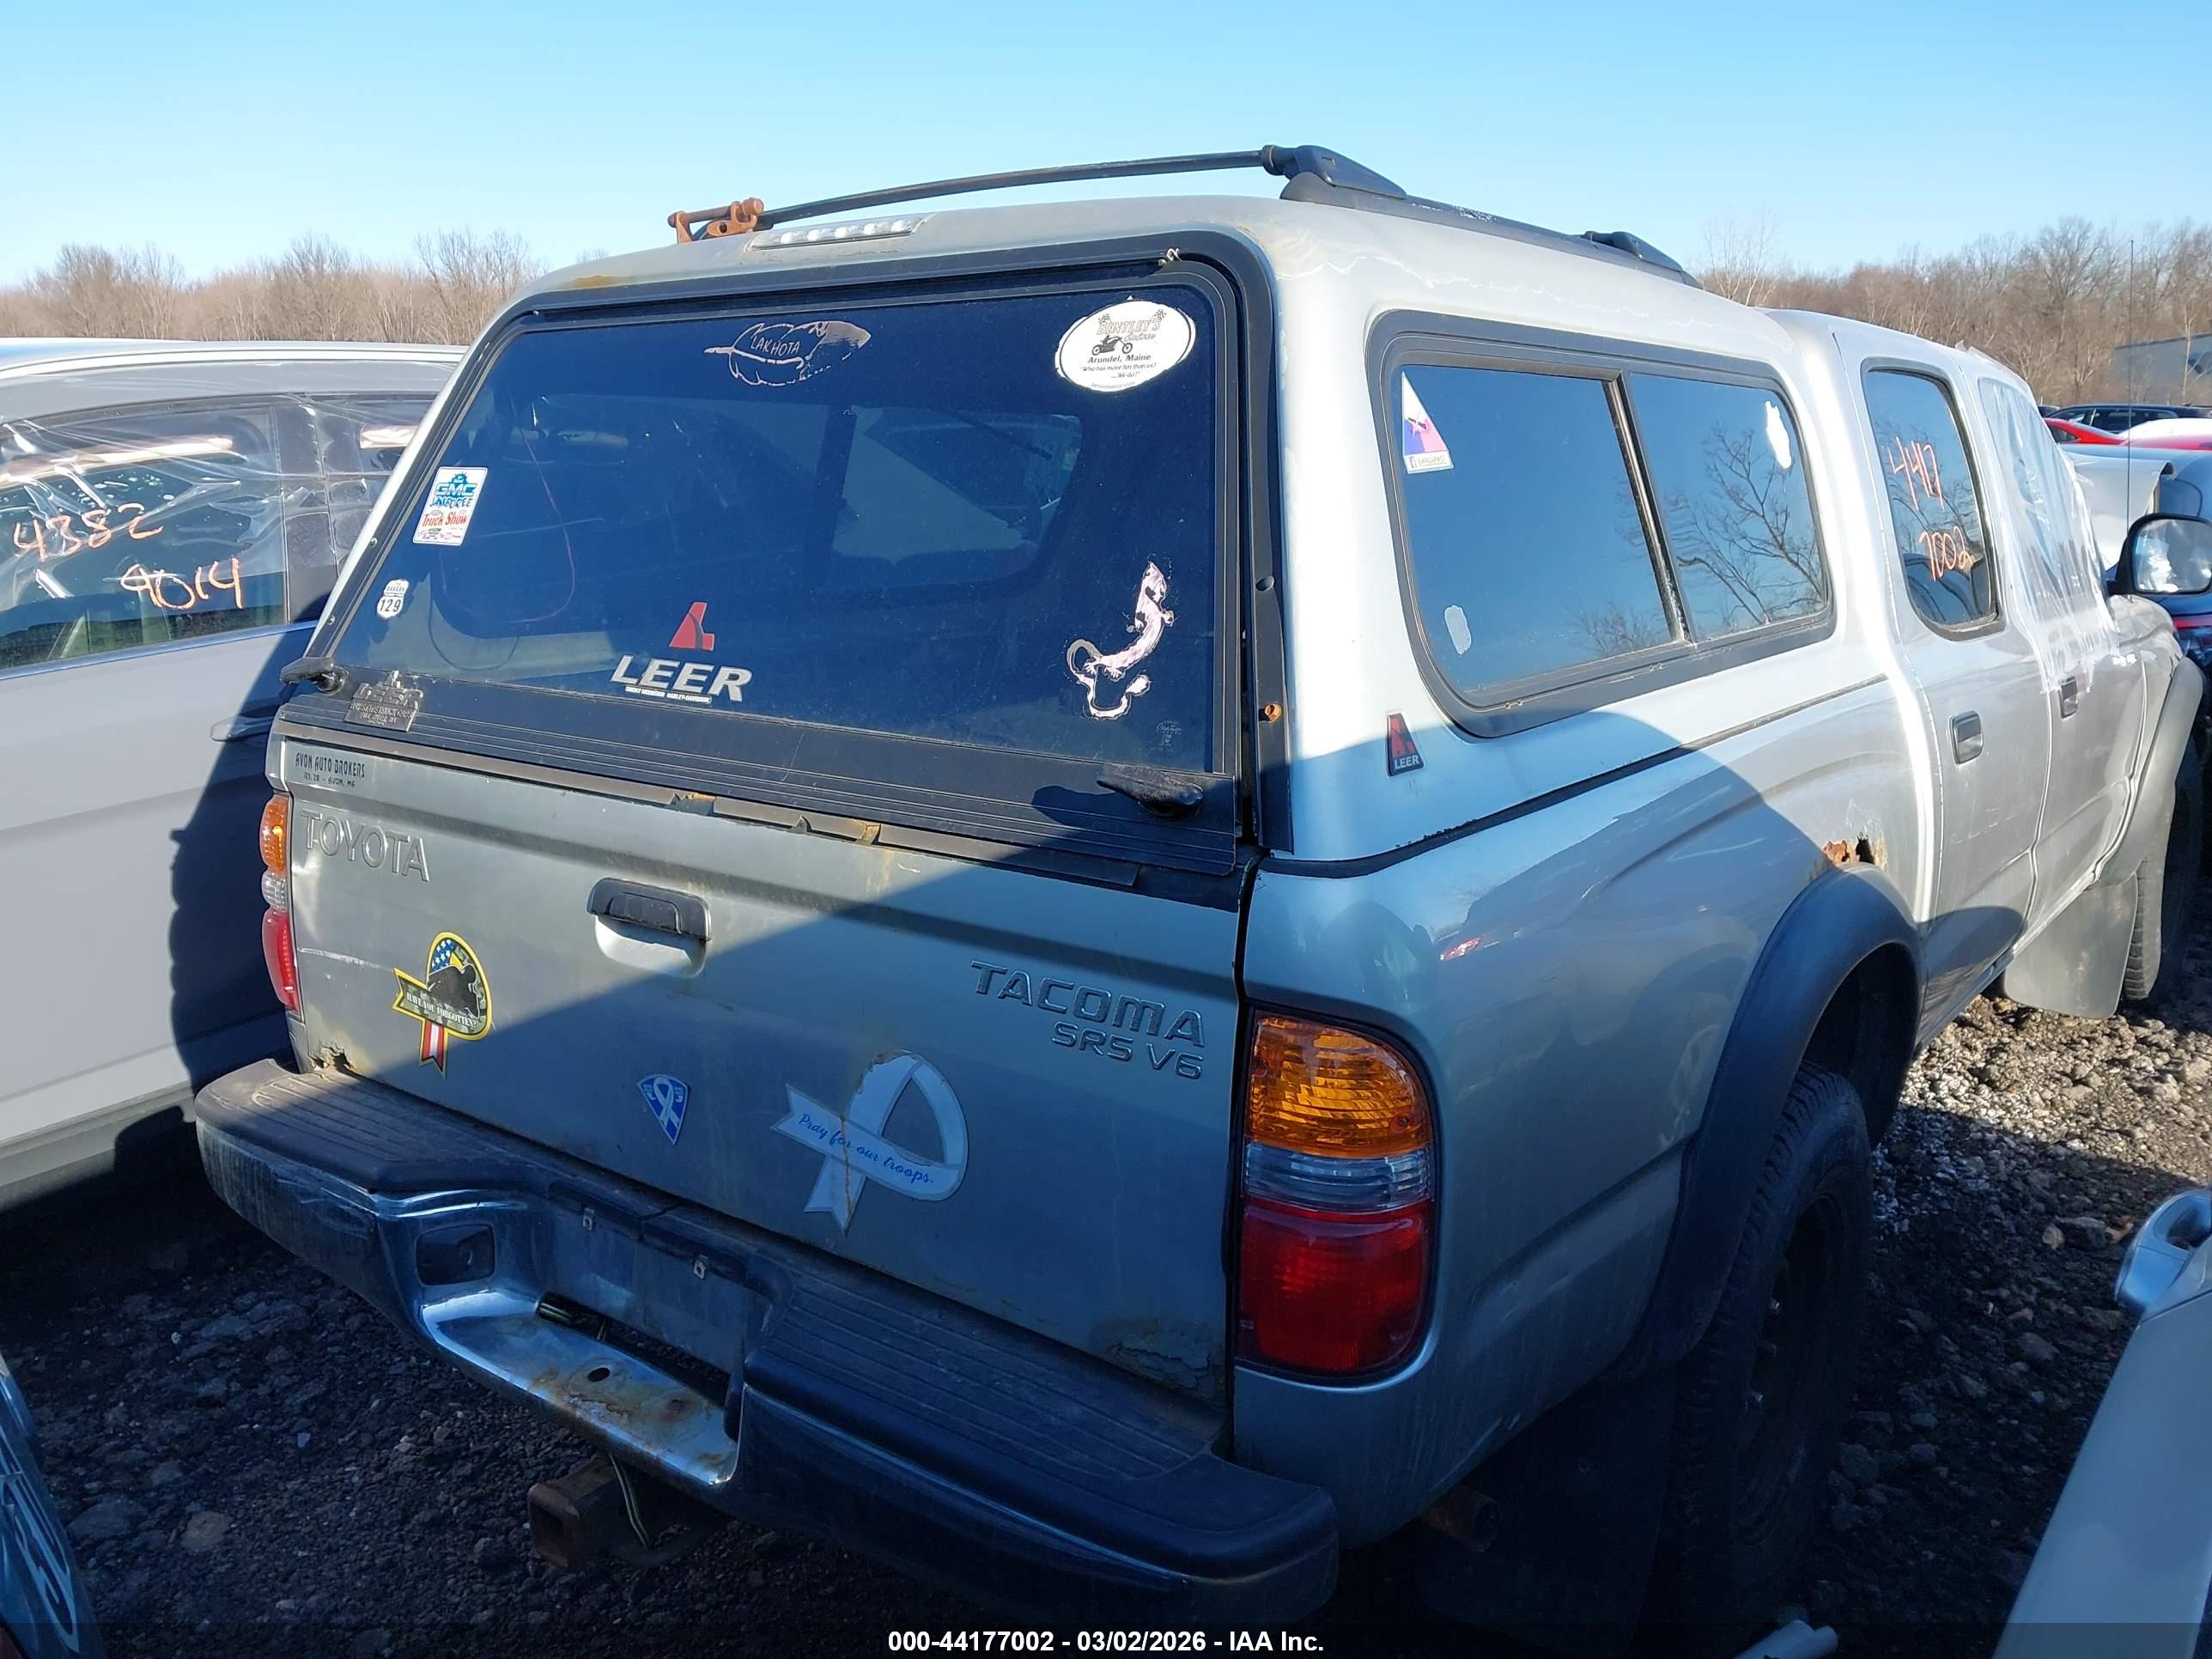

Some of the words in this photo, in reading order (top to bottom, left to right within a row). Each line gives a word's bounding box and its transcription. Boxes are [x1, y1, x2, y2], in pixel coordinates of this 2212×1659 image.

[750, 335, 800, 356] LAKHOTA
[1087, 356, 1121, 364] Arundel,
[13, 502, 164, 562] 4382
[422, 513, 445, 527] Truck
[445, 510, 468, 526] Show
[119, 556, 244, 611] 9014
[380, 599, 402, 612] 129
[611, 654, 752, 702] LEER
[295, 752, 313, 769] AVON
[314, 757, 332, 772] AUTO
[334, 759, 365, 778] BROKERS
[1394, 755, 1420, 770] LEER
[301, 809, 430, 882] TOYOTA
[970, 958, 1205, 1048] TACOMA
[1051, 1020, 1133, 1062] SR5
[1146, 1042, 1204, 1079] V6
[798, 1113, 829, 1140] Pray
[829, 1127, 852, 1147] for
[855, 1146, 879, 1162] our
[883, 1155, 934, 1184] troops.
